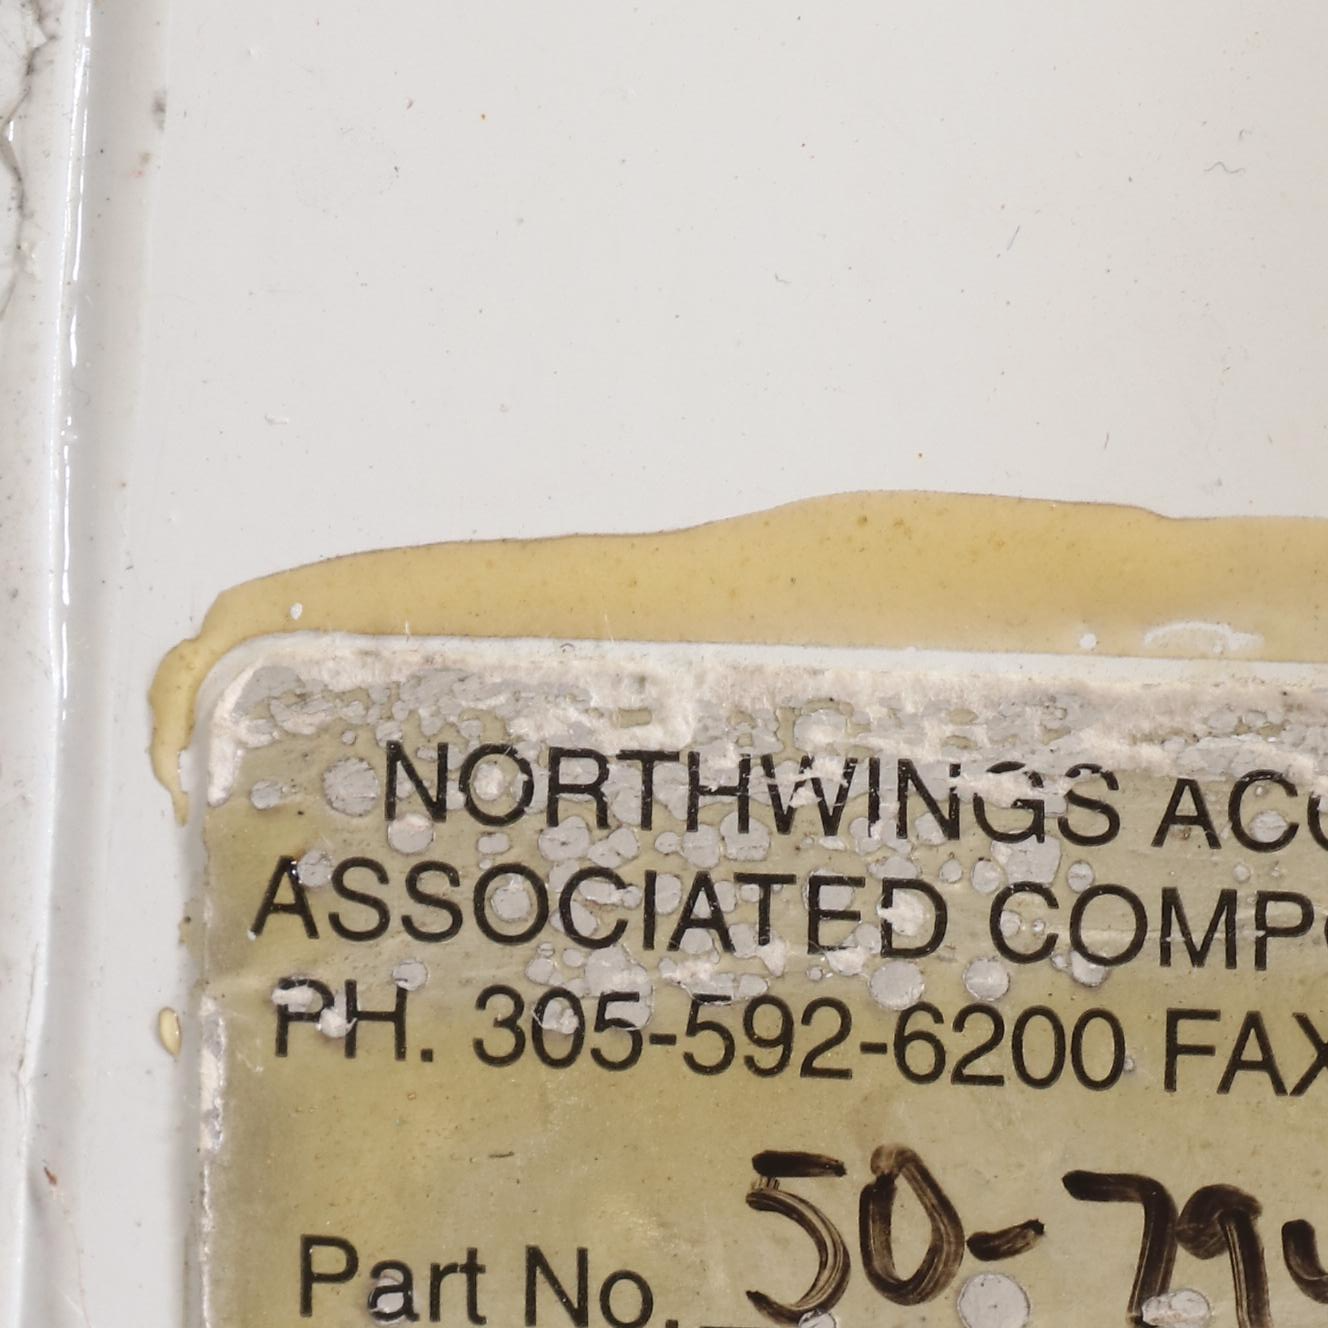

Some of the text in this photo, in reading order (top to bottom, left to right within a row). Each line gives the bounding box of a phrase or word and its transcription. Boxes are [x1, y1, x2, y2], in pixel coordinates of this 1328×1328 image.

[382, 738, 1122, 850] NORTHWINGS
[250, 855, 950, 961] ASSOCIATED
[273, 978, 435, 1064] PH.
[472, 982, 1128, 1092] 305-592-6200
[298, 1233, 487, 1326] Part
